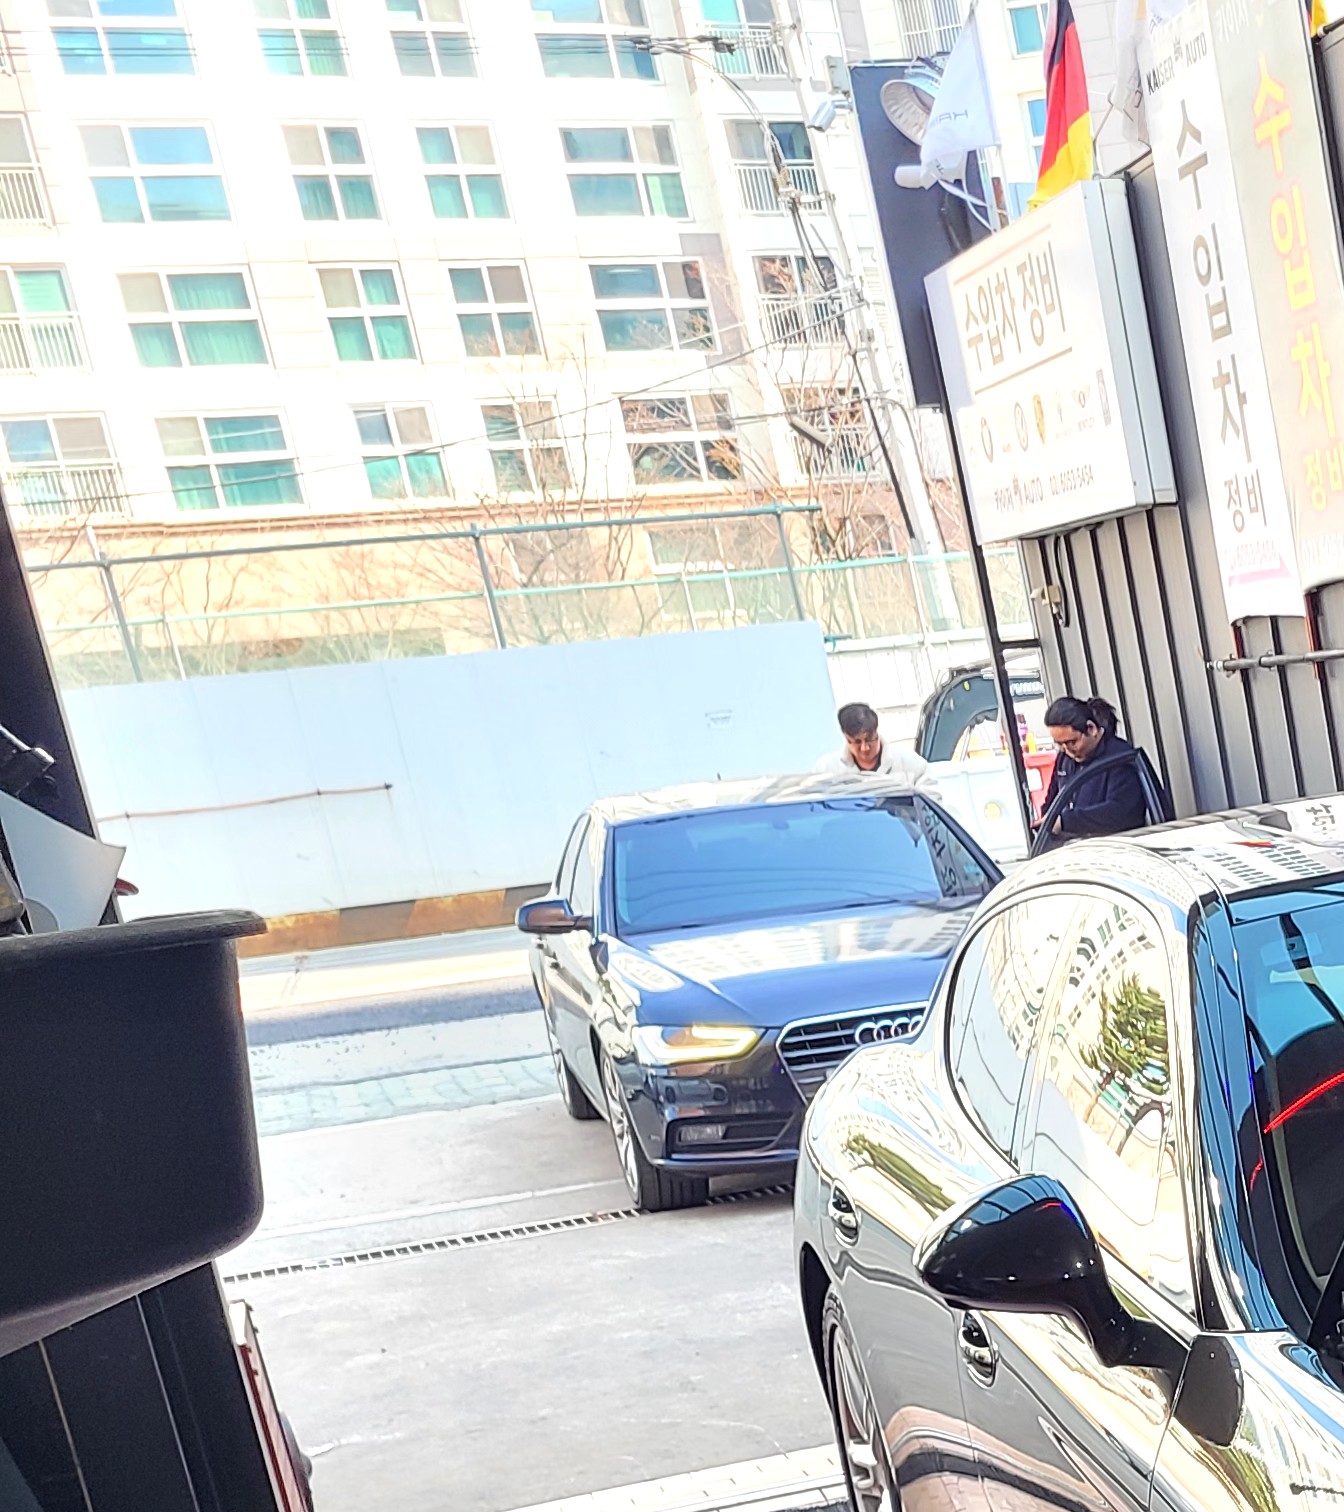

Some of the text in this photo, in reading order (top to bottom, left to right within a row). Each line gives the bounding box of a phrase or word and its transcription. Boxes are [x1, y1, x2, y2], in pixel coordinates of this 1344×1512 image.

[1146, 32, 1207, 96] KAISER AUTO
[965, 241, 1066, 372] 수입차 정비
[1176, 99, 1251, 464] 수입차
[1253, 51, 1336, 438] 수입차
[1224, 469, 1268, 533] 정비
